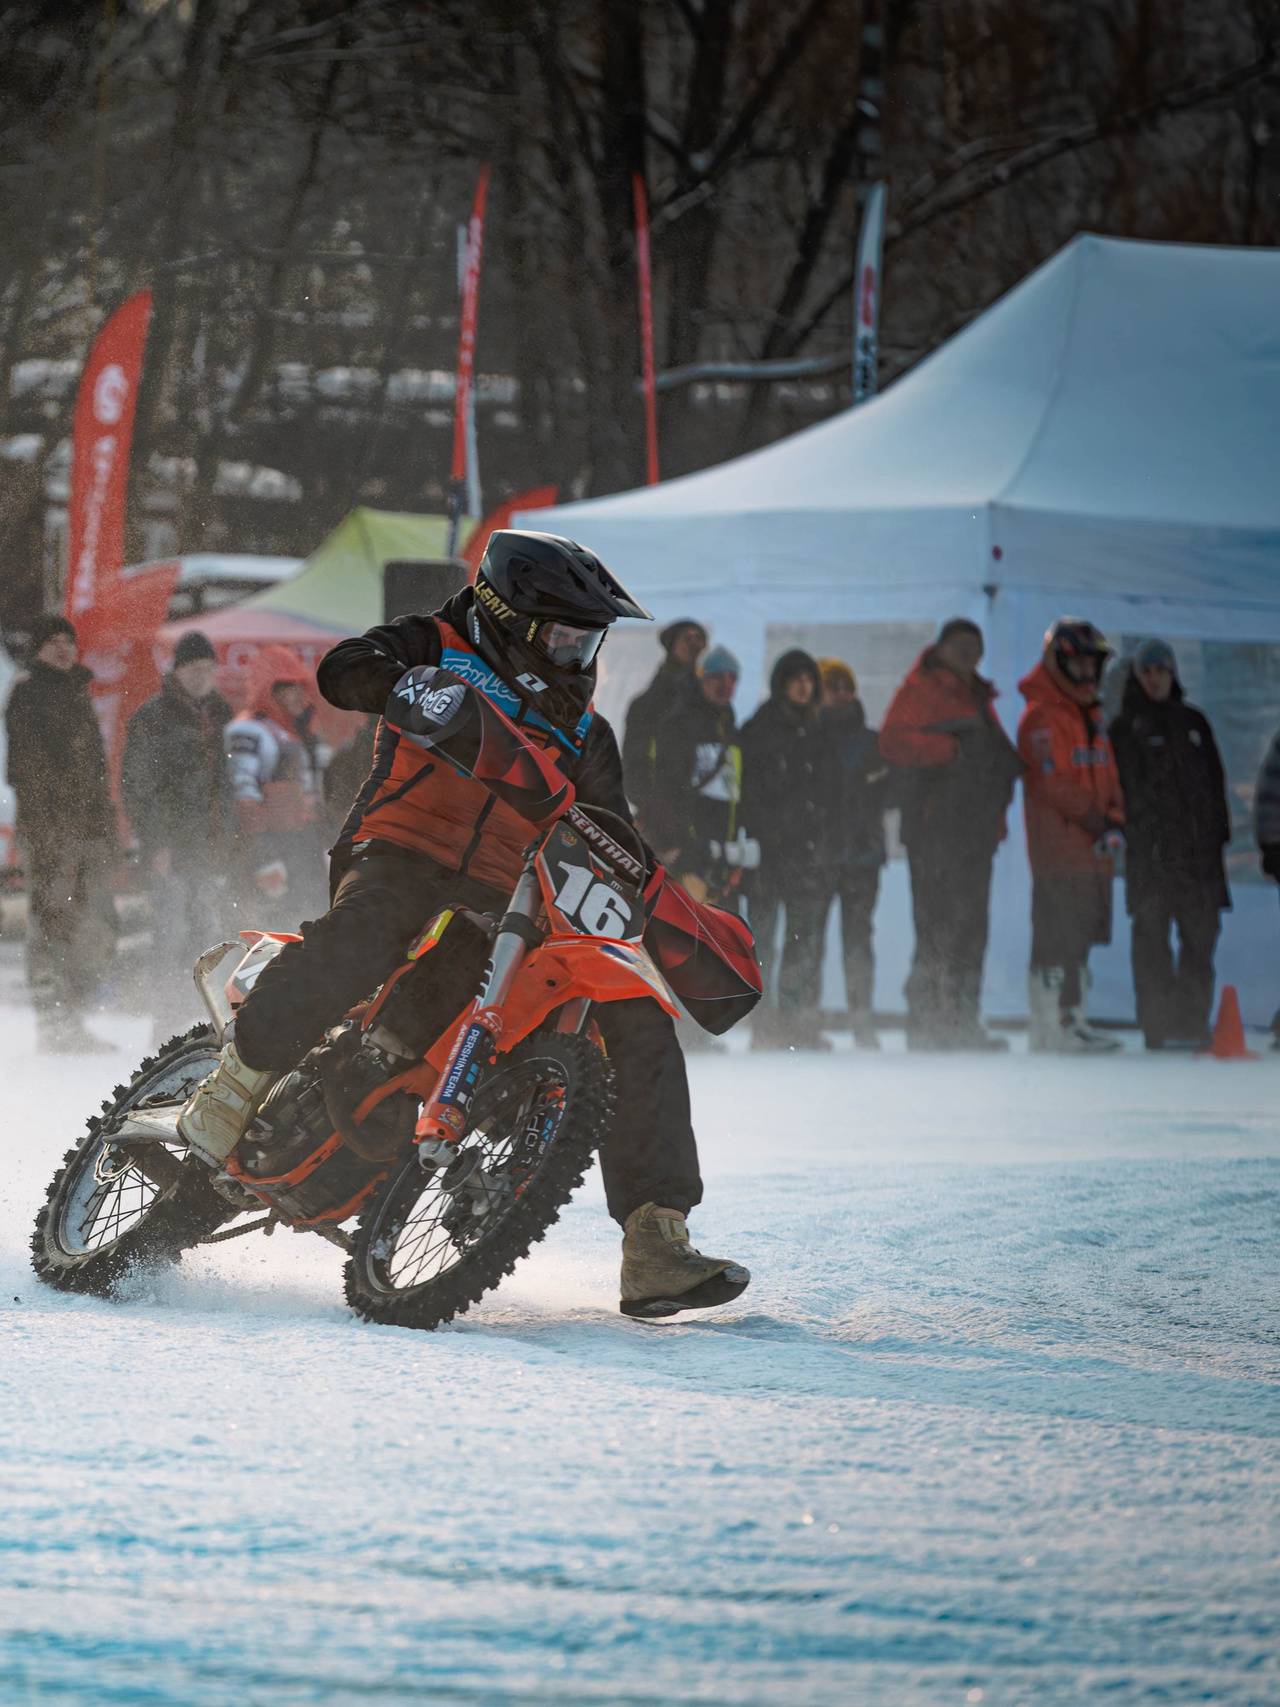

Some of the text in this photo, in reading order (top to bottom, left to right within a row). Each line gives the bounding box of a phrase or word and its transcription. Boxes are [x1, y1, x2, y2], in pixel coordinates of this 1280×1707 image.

[475, 581, 518, 620] LEATT
[569, 808, 641, 880] RENTHAL
[554, 861, 632, 940] 16
[442, 1028, 480, 1098] PERSHINTEAM
